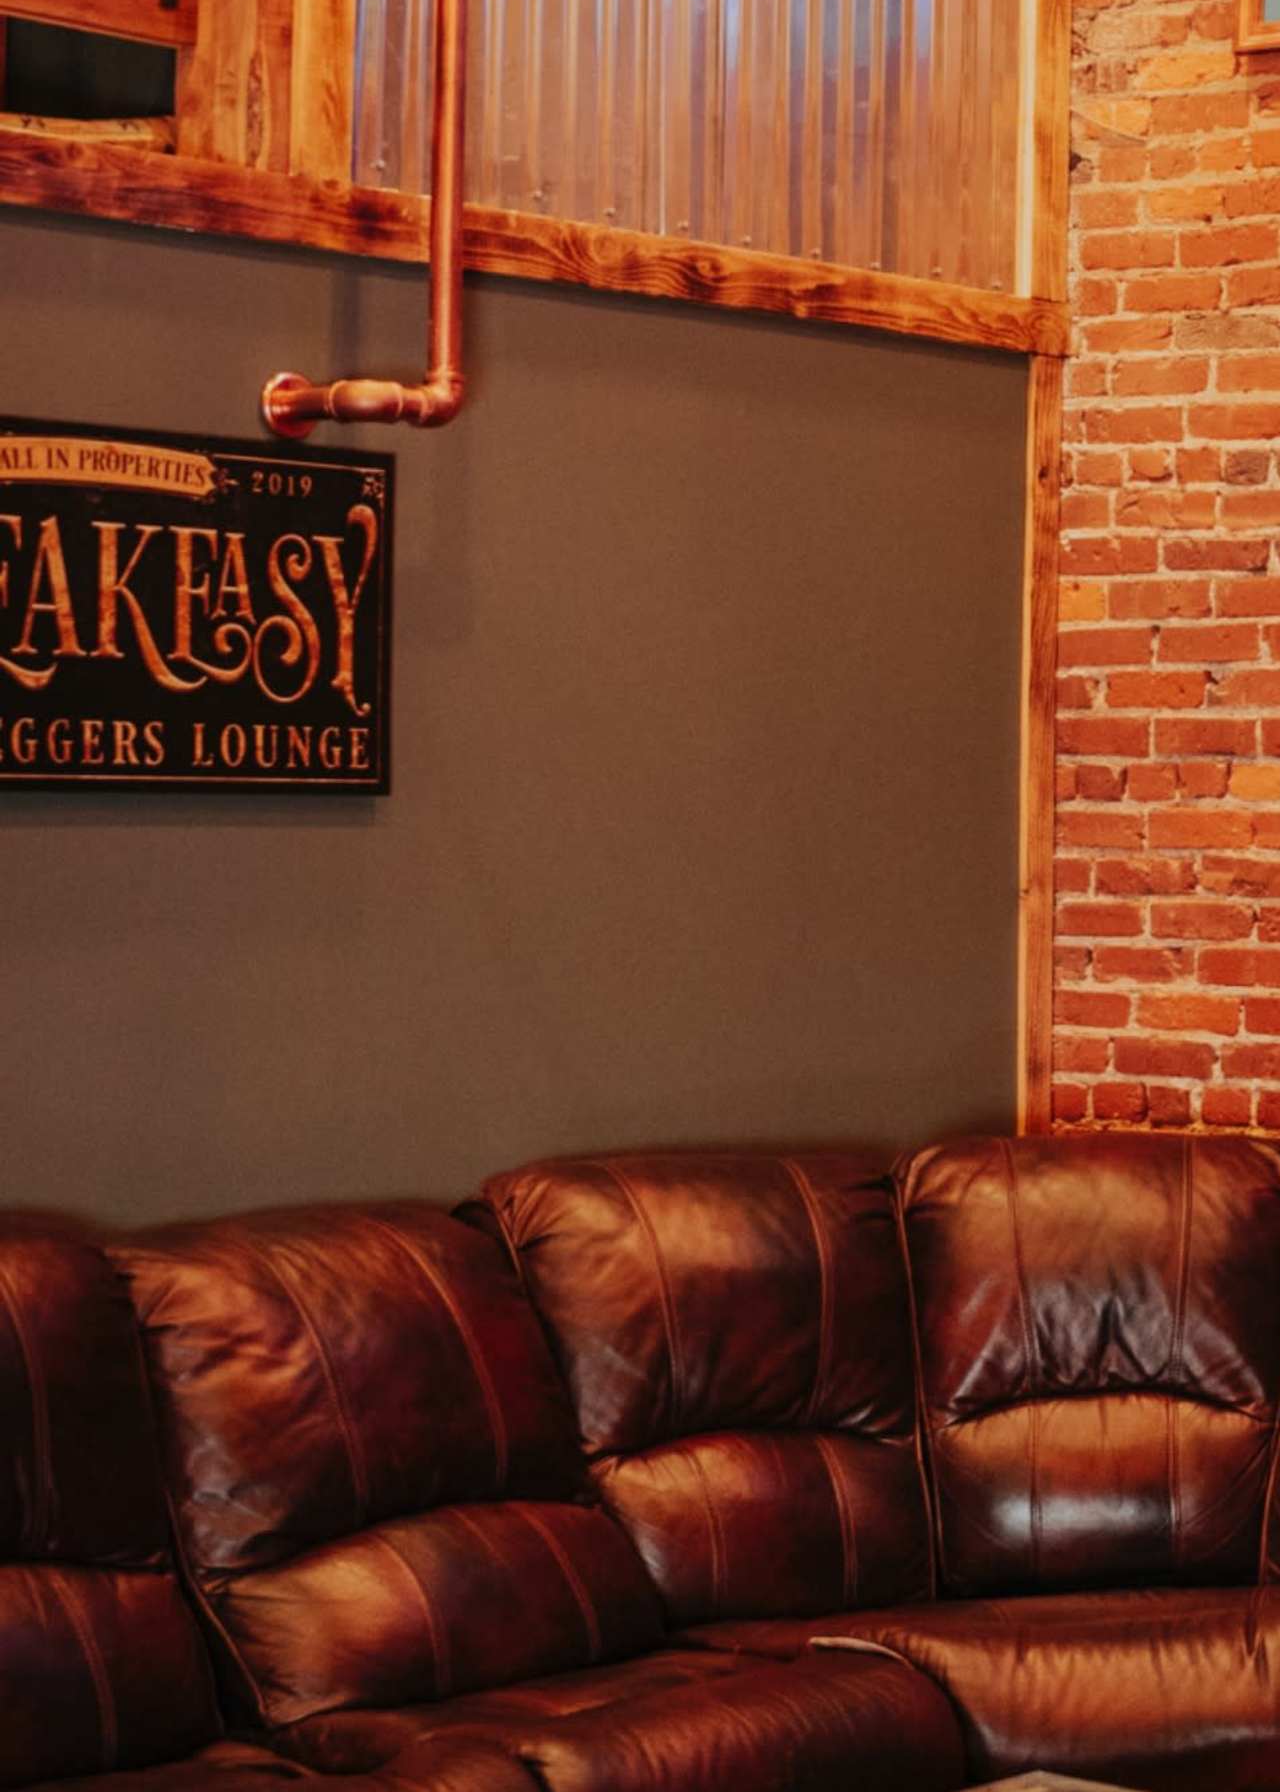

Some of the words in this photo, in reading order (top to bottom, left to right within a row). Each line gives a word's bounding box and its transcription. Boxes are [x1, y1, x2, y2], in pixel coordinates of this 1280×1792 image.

[46, 446, 69, 470] IN
[79, 448, 206, 489] PROPERTIES
[251, 471, 313, 496] 2019
[193, 722, 370, 770] LOUNGE
